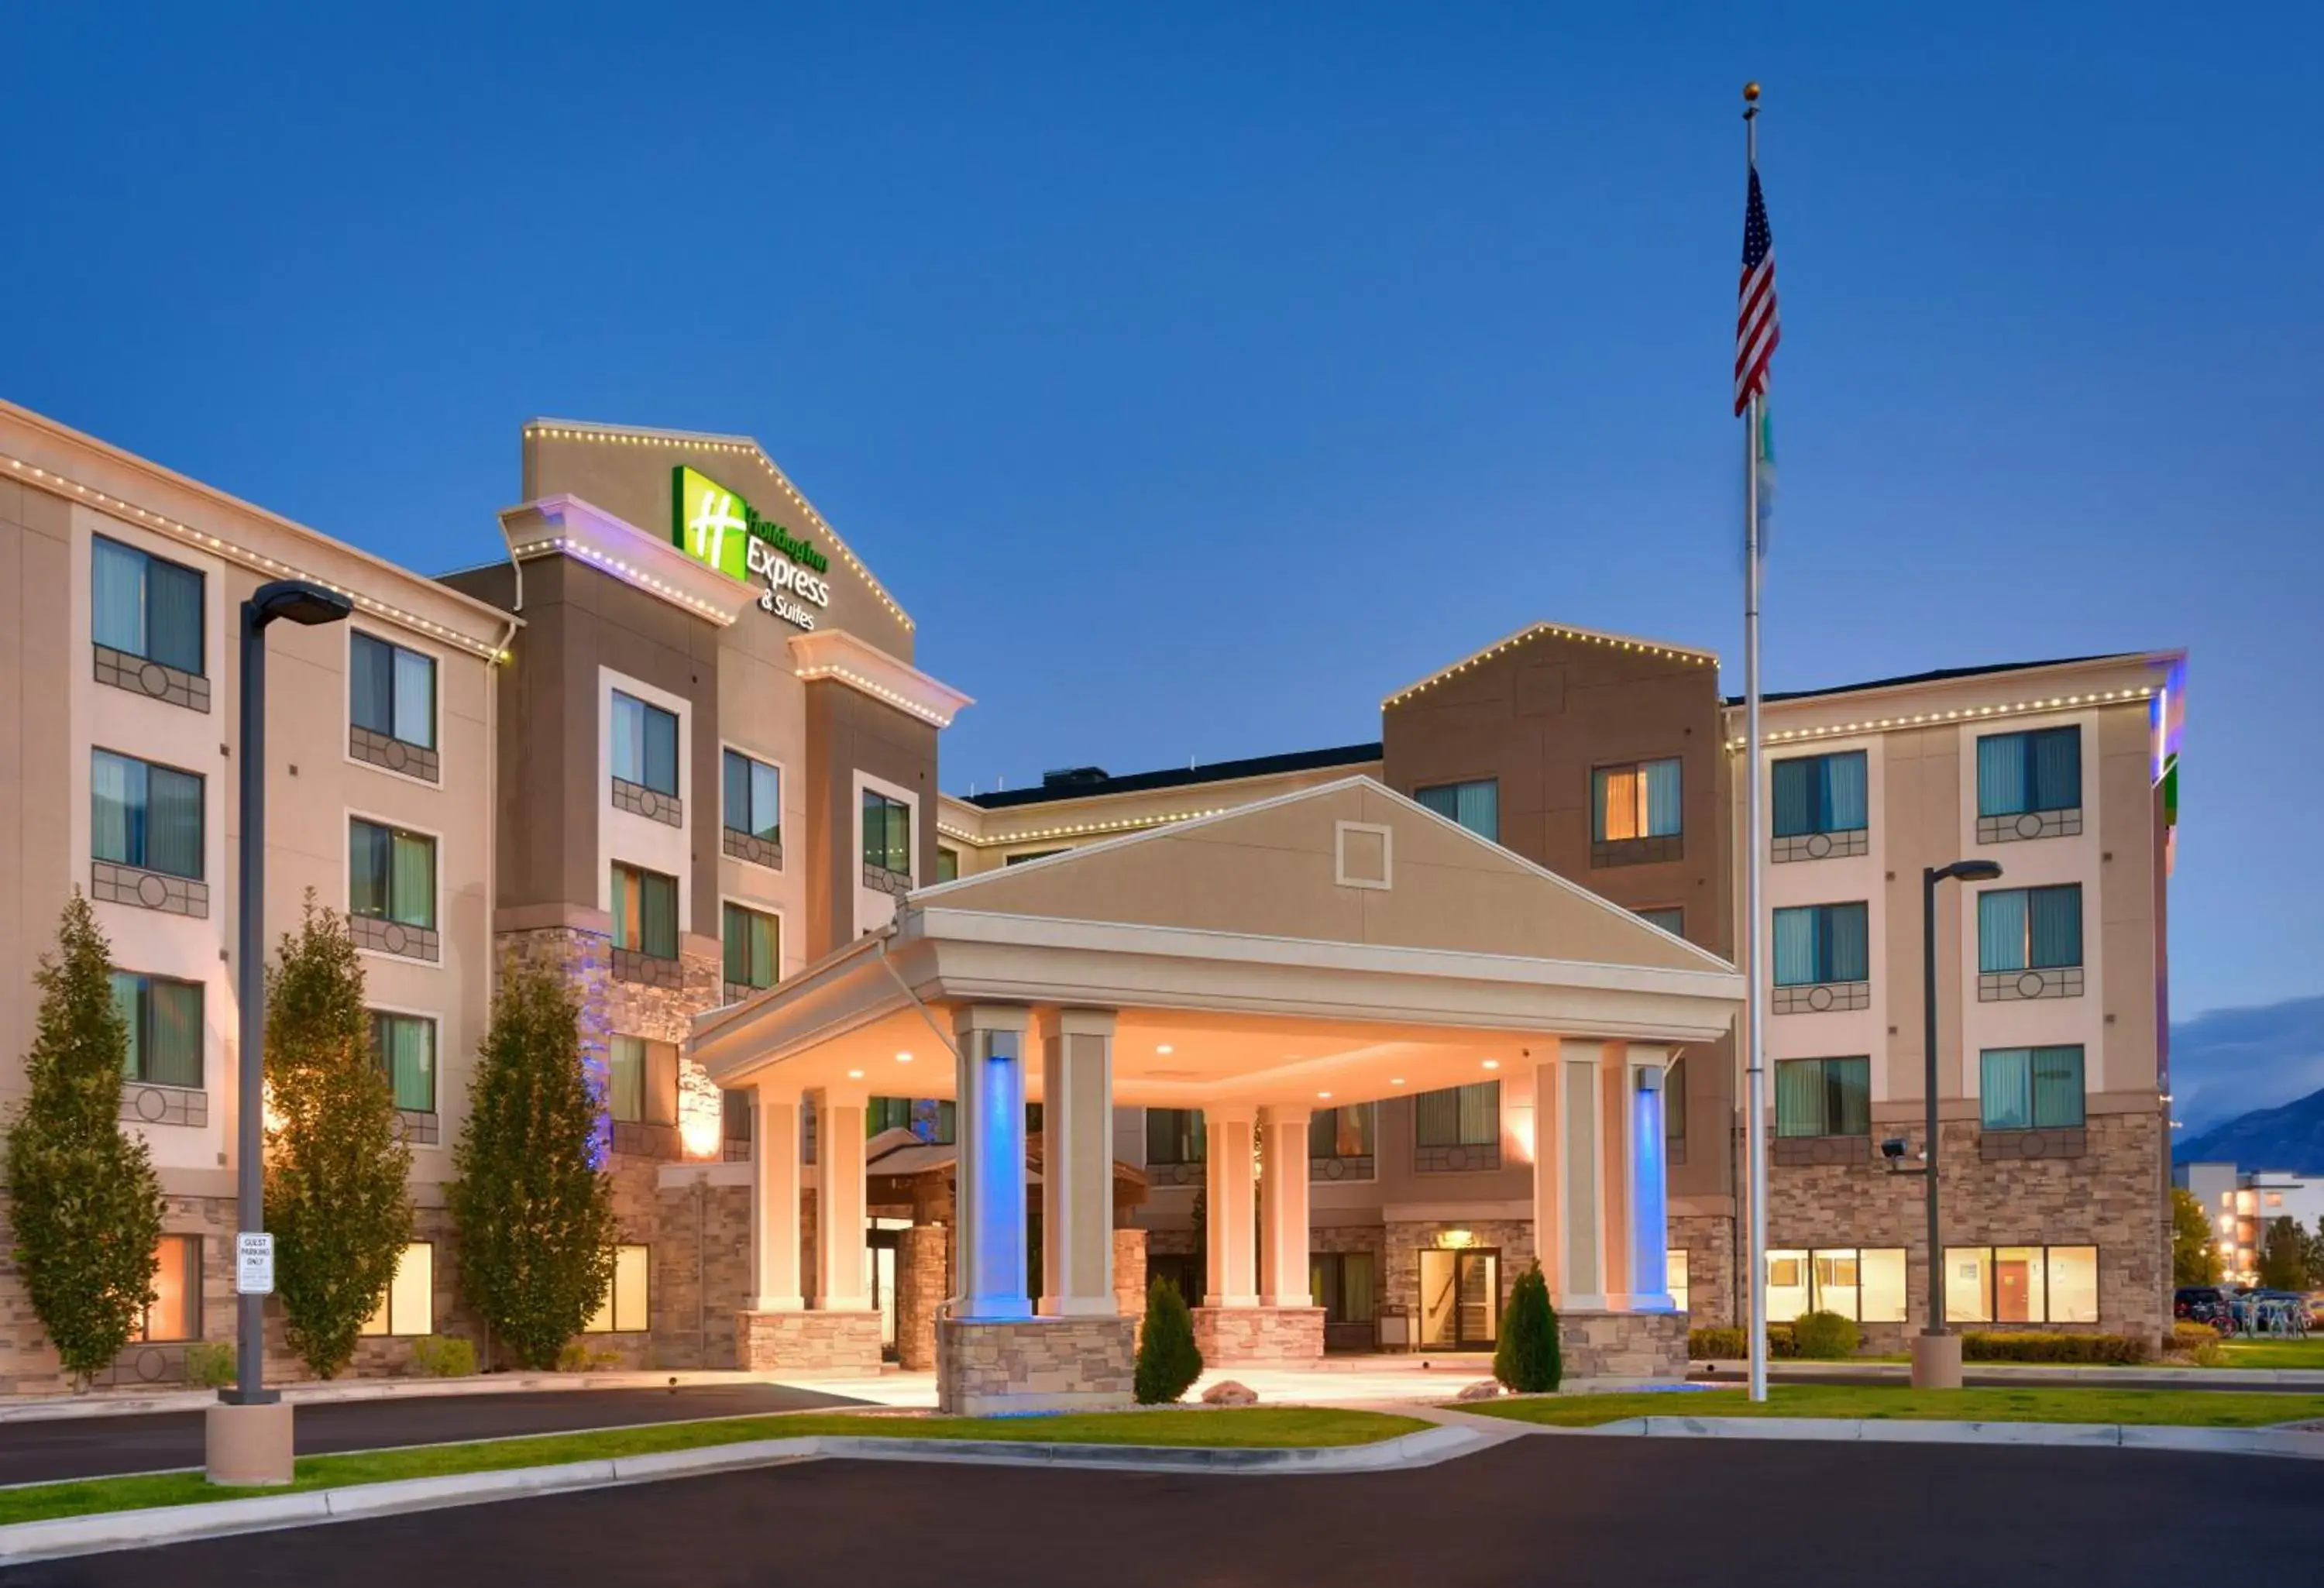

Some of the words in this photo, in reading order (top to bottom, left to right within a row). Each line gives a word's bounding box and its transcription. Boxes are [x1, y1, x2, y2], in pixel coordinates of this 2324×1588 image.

[747, 535, 830, 607] Express
[761, 588, 772, 611] &
[774, 595, 814, 631] Suites
[246, 1256, 263, 1266] ONLY
